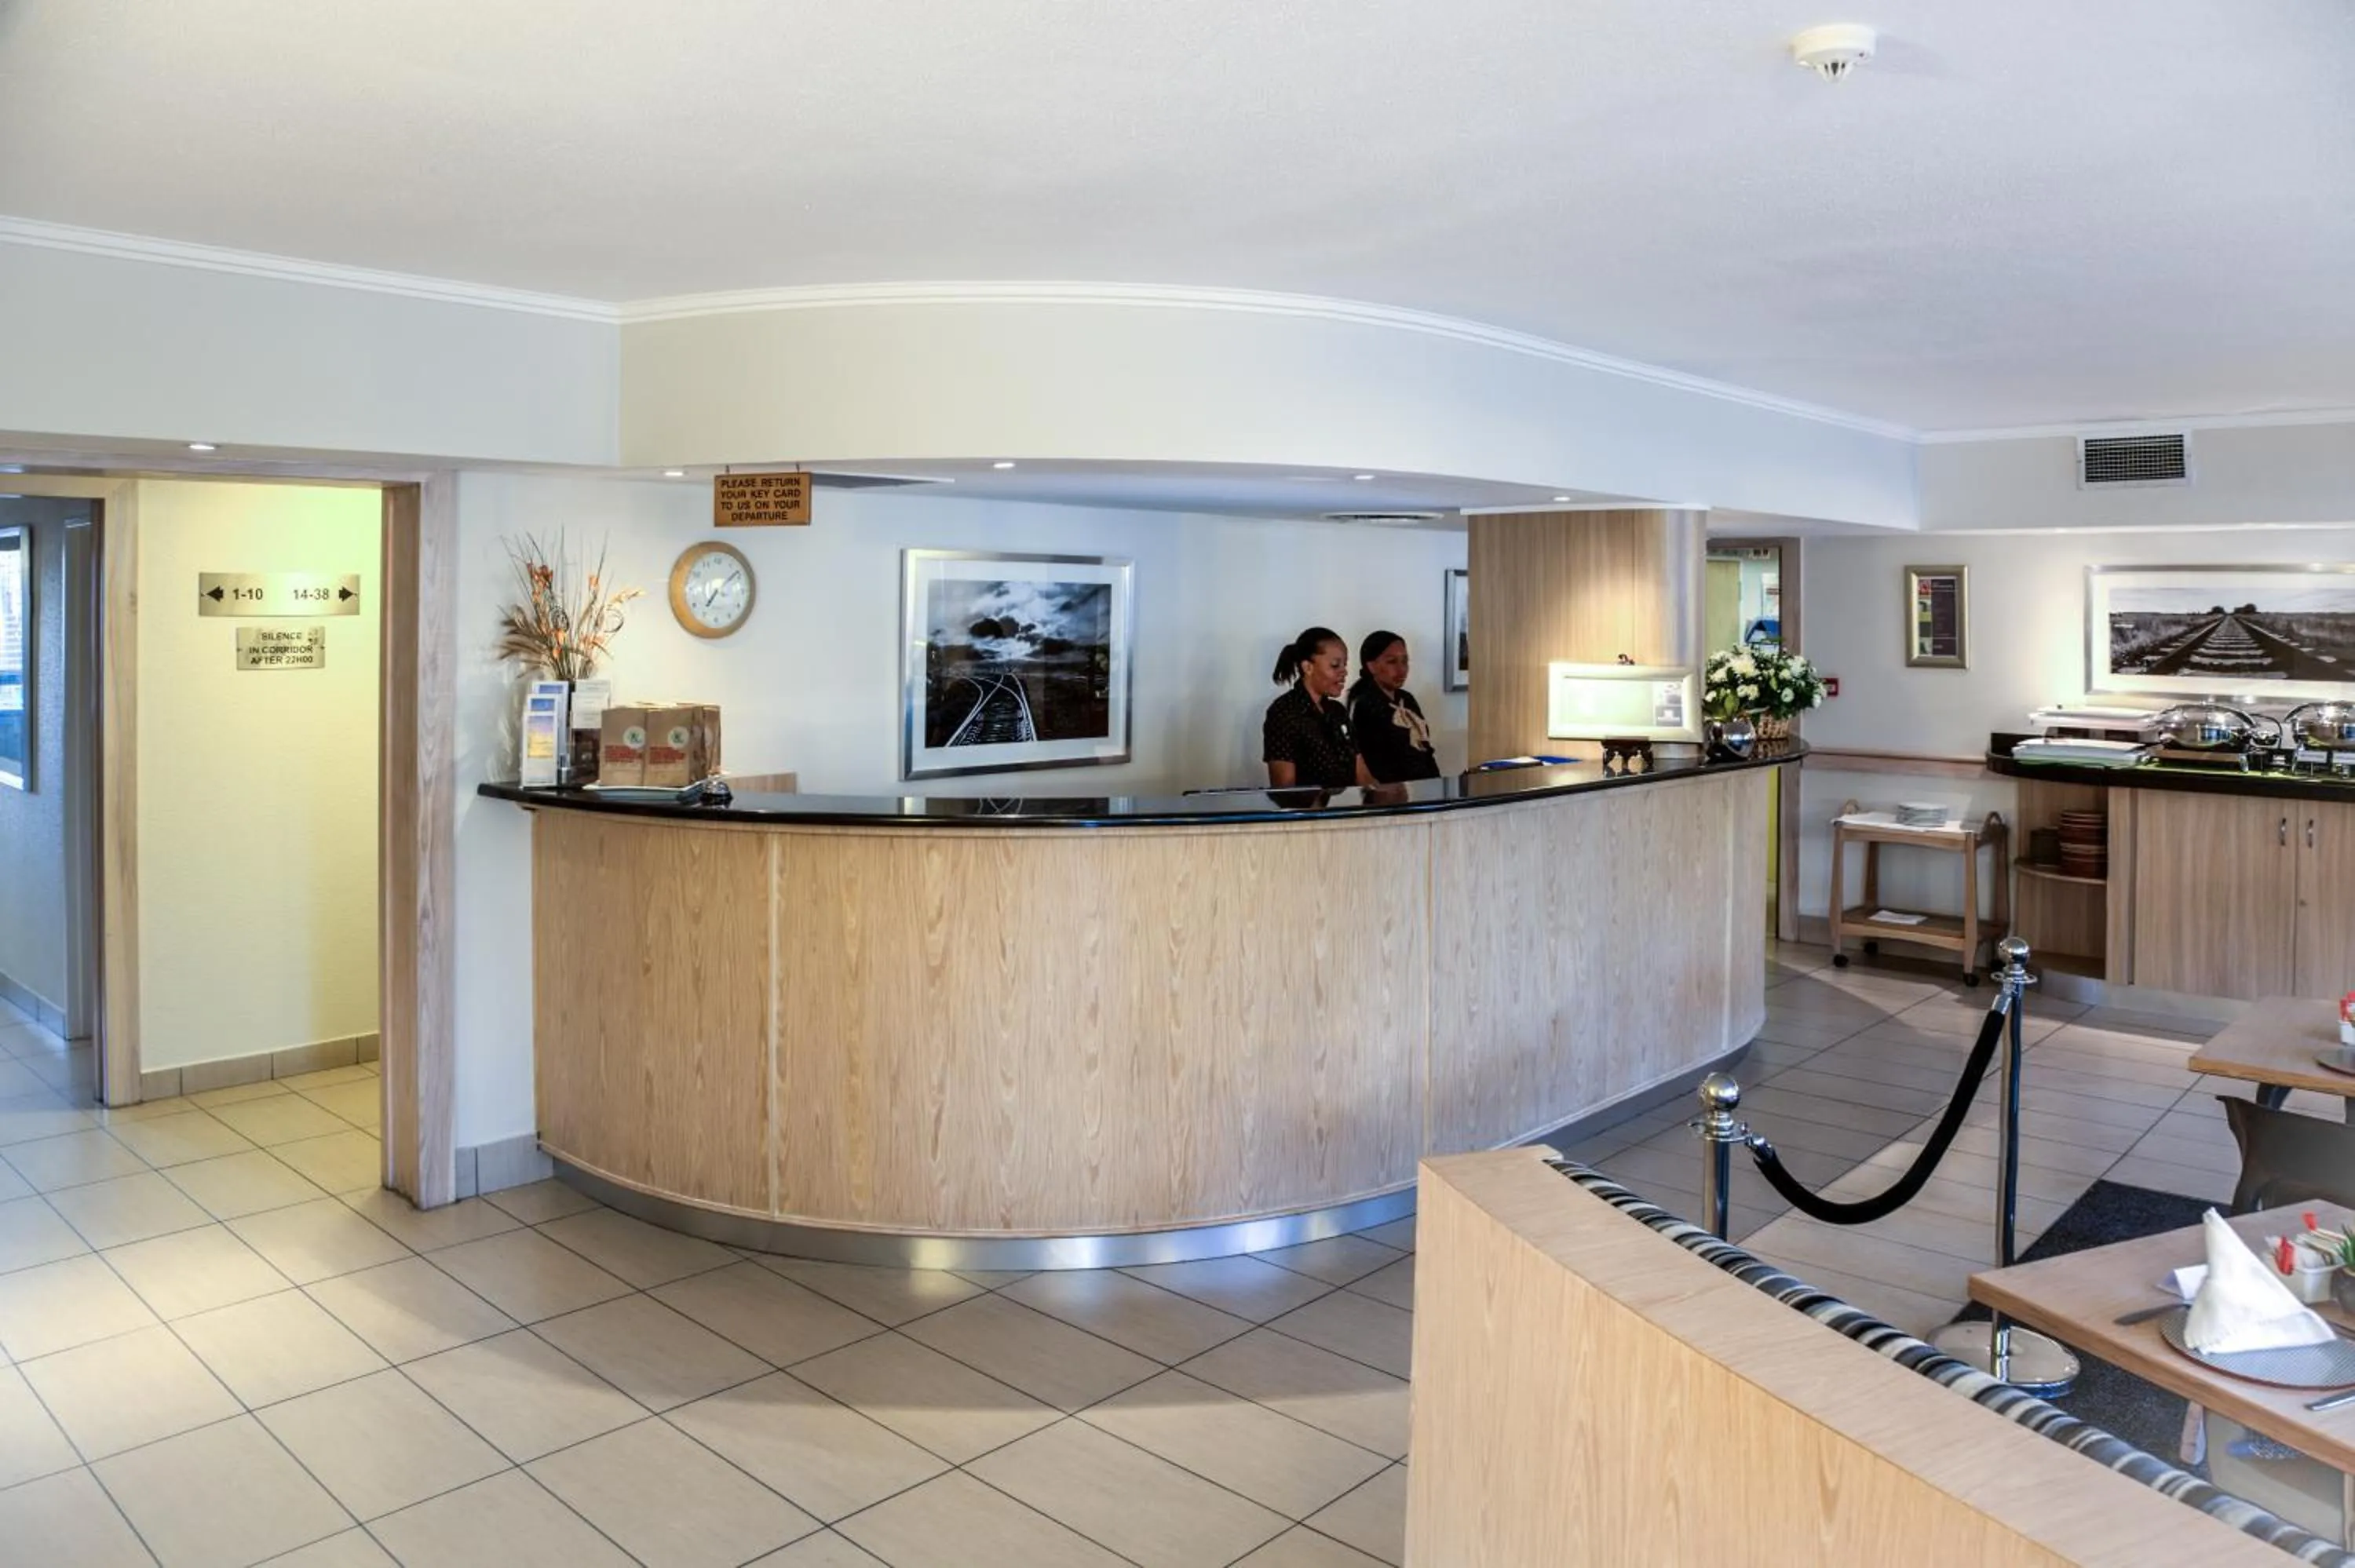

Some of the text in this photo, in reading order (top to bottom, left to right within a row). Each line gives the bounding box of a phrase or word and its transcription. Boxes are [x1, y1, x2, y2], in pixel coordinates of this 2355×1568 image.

[721, 478, 801, 488] PLEASE RETURN
[721, 489, 801, 499] YOUR KEY CARD
[737, 501, 750, 510] US
[774, 500, 801, 509] YOUR
[731, 511, 788, 521] DEPARTURE
[232, 588, 264, 600] 1-10
[293, 588, 330, 600] 14-38
[261, 632, 302, 640] SILENCE
[261, 644, 313, 654] CORRIDOR
[250, 655, 314, 665] AFTER 22H00
